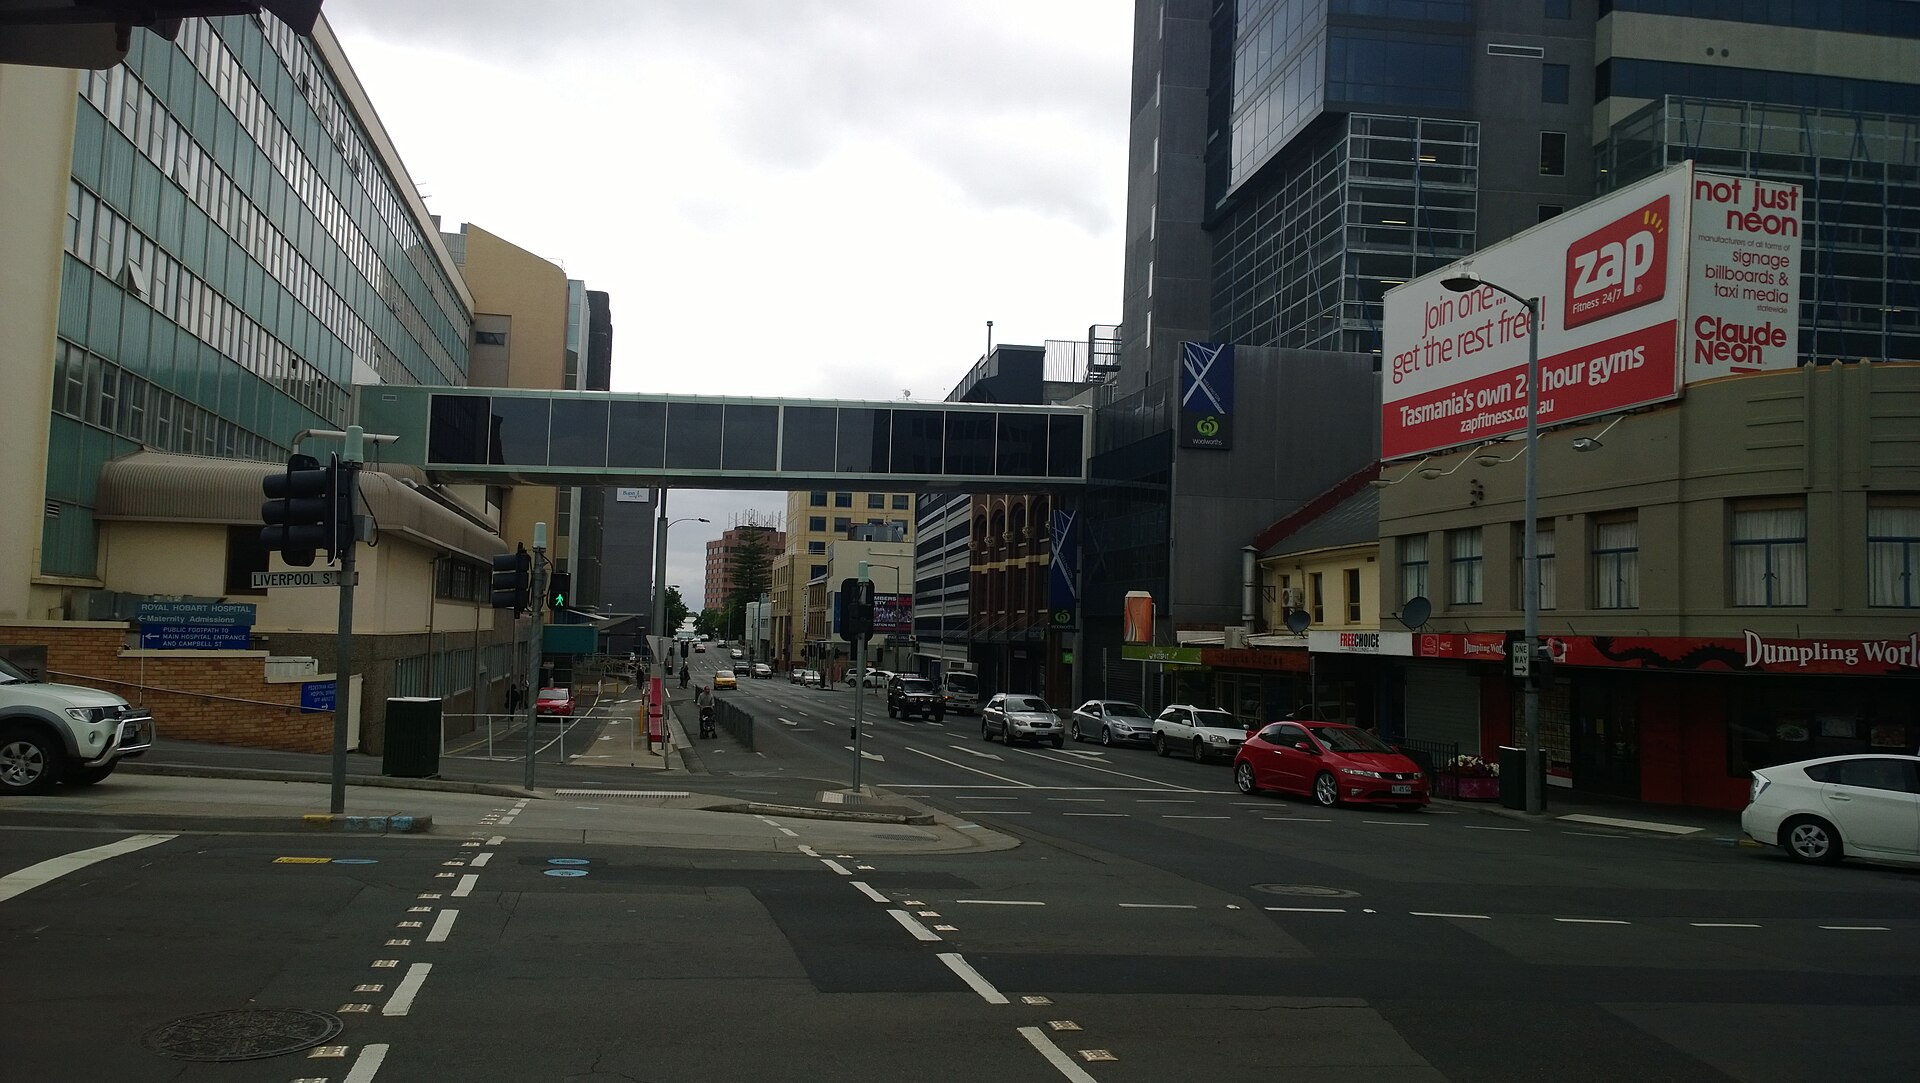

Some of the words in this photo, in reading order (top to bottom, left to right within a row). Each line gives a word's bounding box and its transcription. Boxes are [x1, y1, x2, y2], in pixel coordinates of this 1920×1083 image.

[1696, 180, 1741, 204] not
[1752, 181, 1798, 211] just
[1727, 210, 1797, 237] neon
[1698, 234, 1746, 246] manufacturers
[1764, 242, 1782, 250] forms
[1574, 230, 1654, 298] zap
[1733, 249, 1789, 270] signage
[1705, 264, 1774, 284] billboards
[1779, 272, 1788, 285] &
[1573, 299, 1599, 314] Fitness
[1602, 289, 1622, 304] 24/7
[1715, 283, 1738, 298] taxi
[1743, 287, 1788, 303] media
[1422, 296, 1453, 339] Join
[1757, 304, 1787, 313] statewide
[1695, 316, 1787, 347] Claude
[1393, 345, 1420, 384] get
[1424, 336, 1452, 367] the
[1458, 319, 1493, 357] rest
[1695, 340, 1762, 365] Neon
[1400, 389, 1474, 427] Tasmania's
[1477, 382, 1511, 408] own
[1542, 362, 1585, 392] hour
[1589, 346, 1645, 386] gyms
[254, 574, 317, 586] LIVERPOOL
[147, 615, 185, 623] Maternity
[1464, 638, 1490, 655] Dumpling
[1490, 638, 1506, 656] Worl
[1743, 629, 1858, 667] Dumpling
[1862, 633, 1920, 668] Worl
